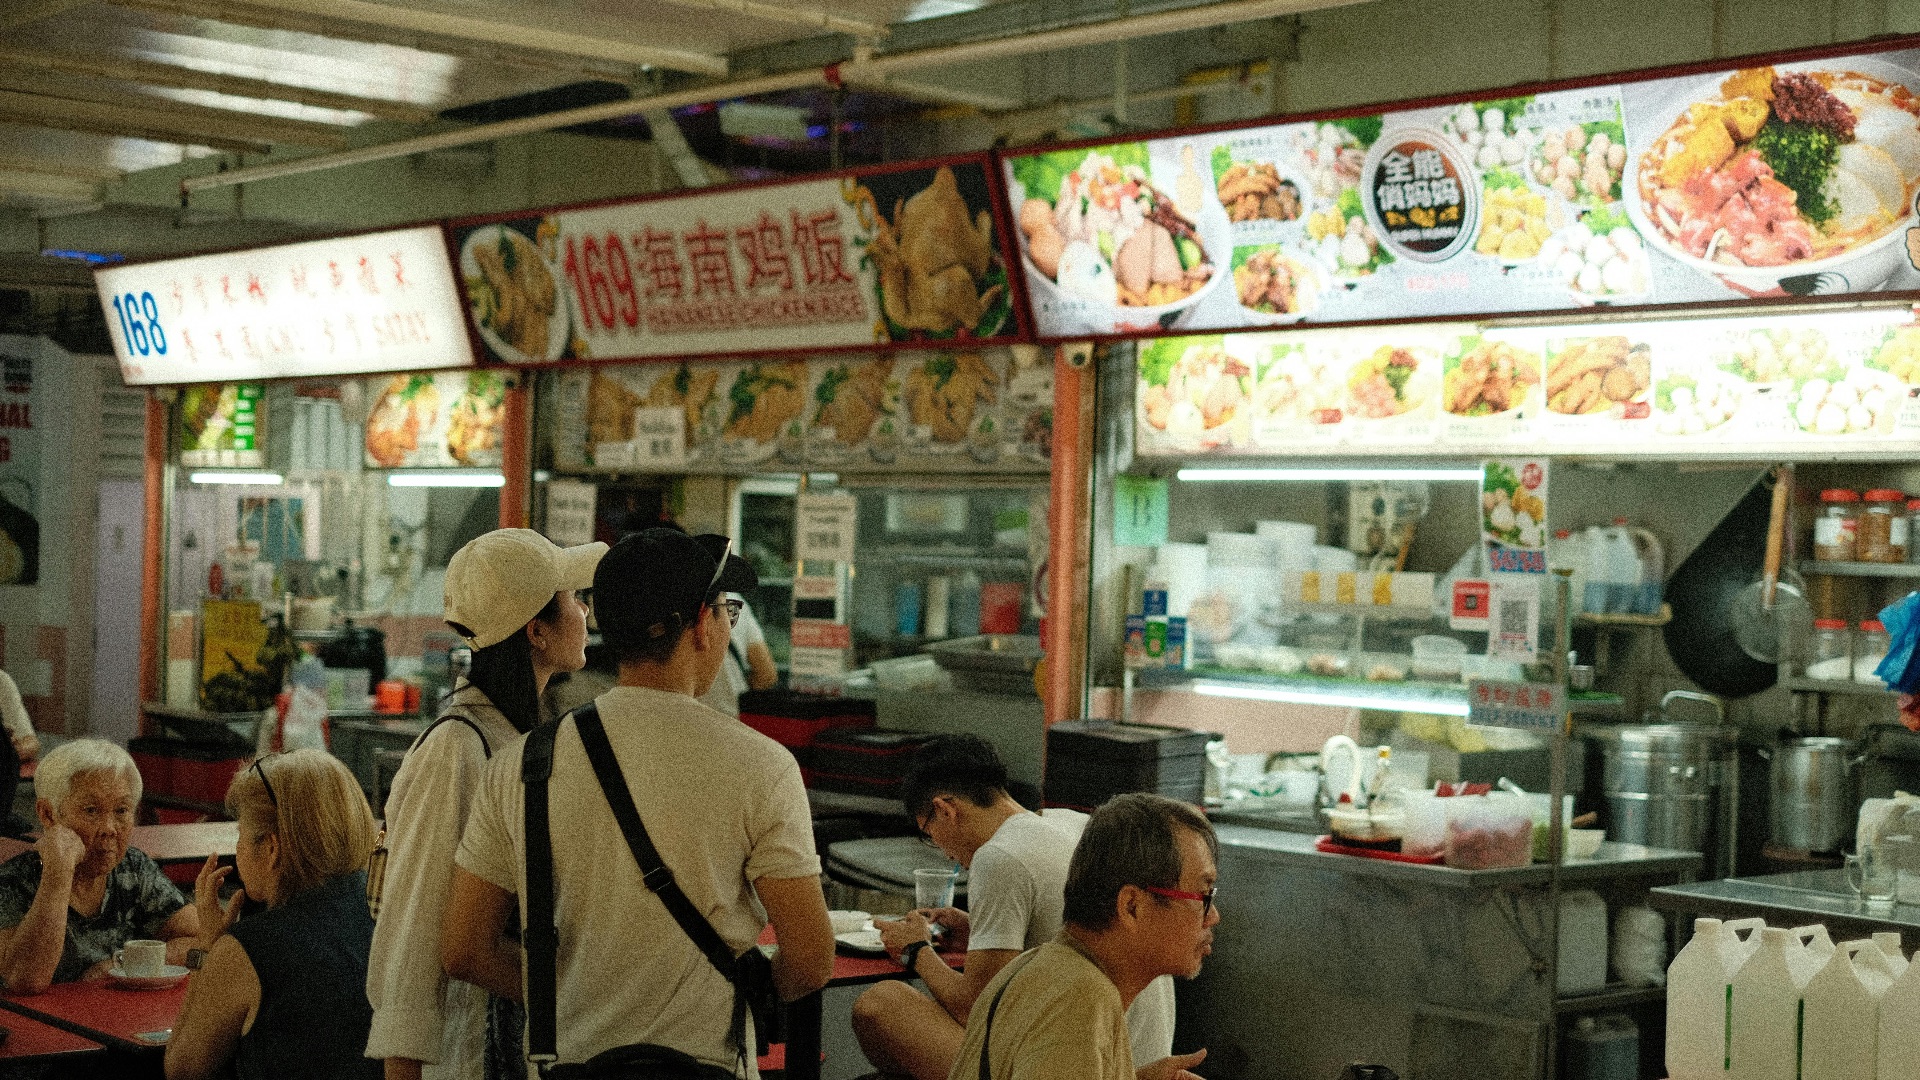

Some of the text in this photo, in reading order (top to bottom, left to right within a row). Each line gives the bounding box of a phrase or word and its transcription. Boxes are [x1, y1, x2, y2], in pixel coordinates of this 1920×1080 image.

[563, 208, 854, 330] 169 海南鸡饭
[113, 288, 168, 357] 168
